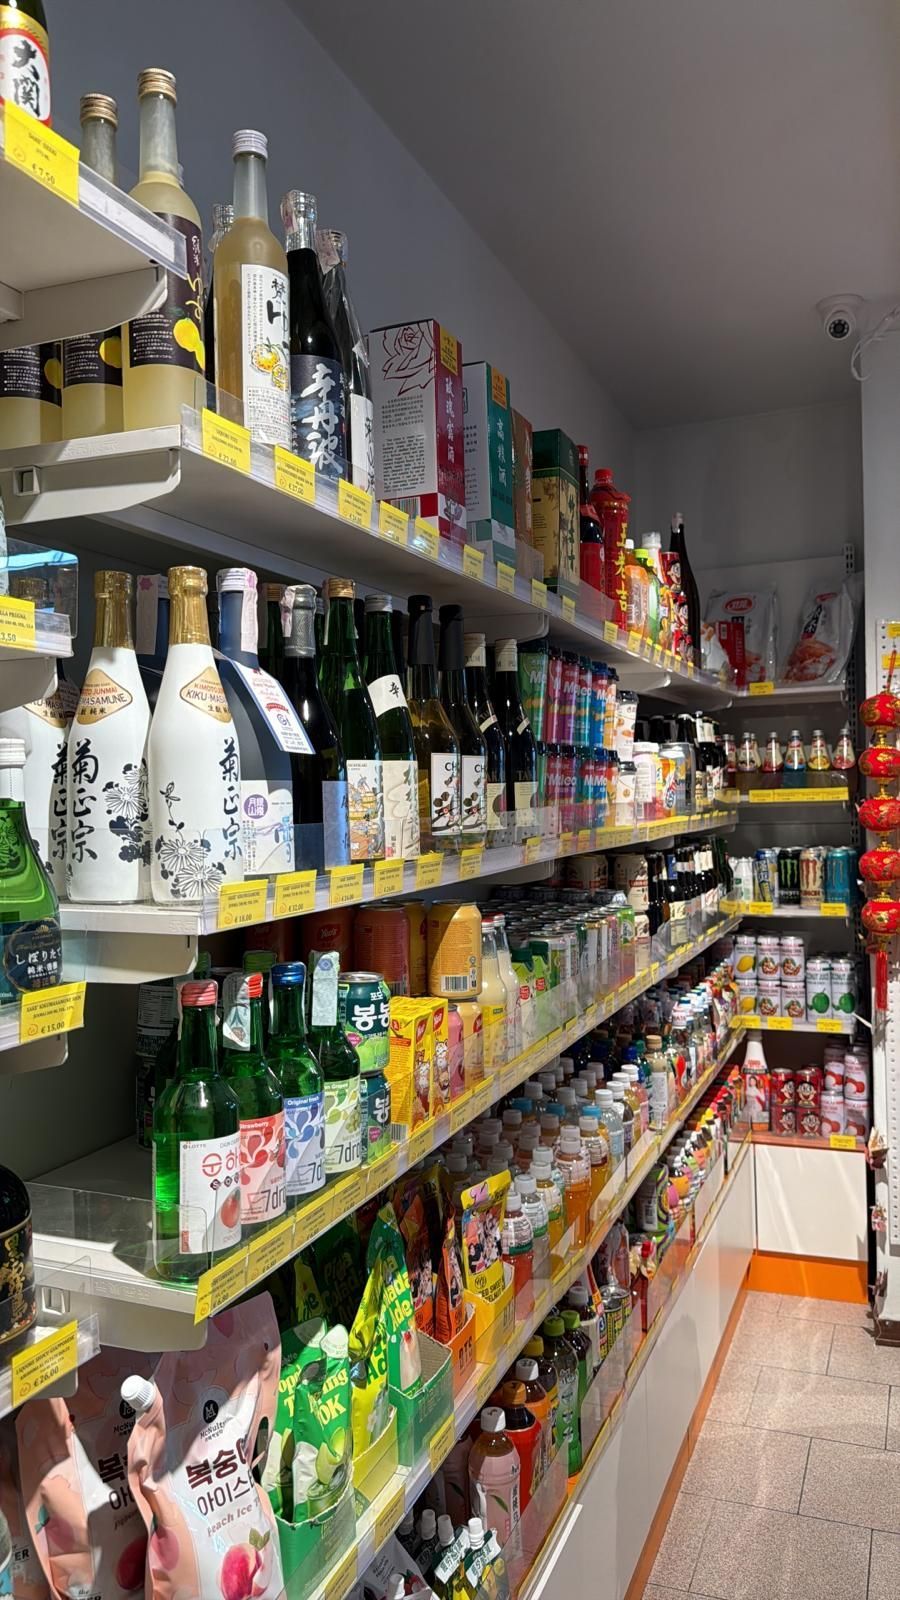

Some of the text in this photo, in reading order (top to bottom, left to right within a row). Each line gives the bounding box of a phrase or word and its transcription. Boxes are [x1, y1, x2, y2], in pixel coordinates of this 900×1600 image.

[12, 39, 41, 117] 大関
[71, 737, 99, 864] 菊正宗
[219, 736, 243, 862] 菊正宗
[15, 947, 62, 966] しぼりたて
[370, 987, 384, 1001] 포도
[367, 1357, 388, 1385] Ad
[98, 1452, 129, 1484] 복
